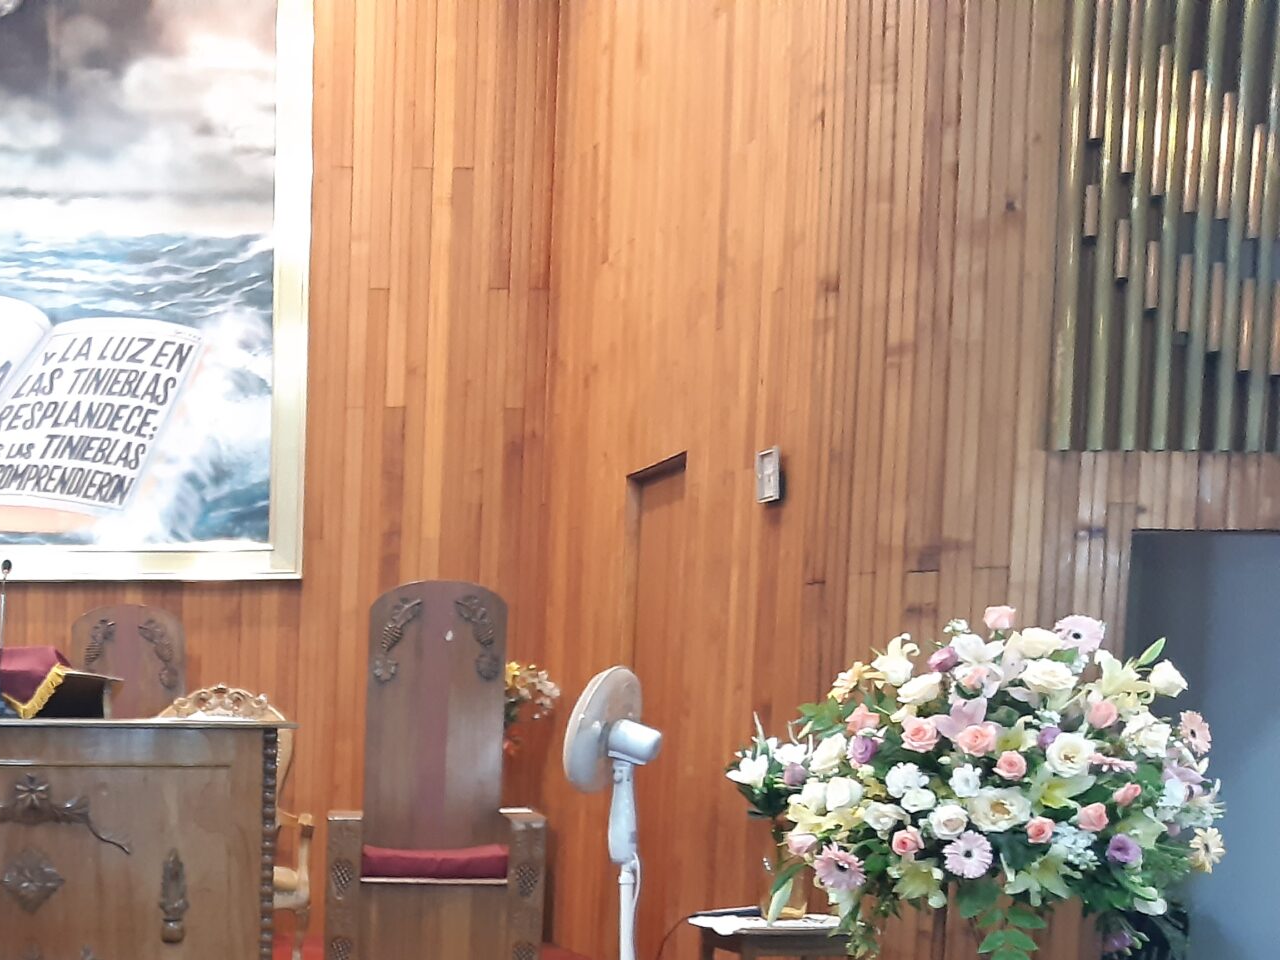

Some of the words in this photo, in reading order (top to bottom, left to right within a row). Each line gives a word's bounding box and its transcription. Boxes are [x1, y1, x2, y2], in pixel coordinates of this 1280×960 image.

[58, 337, 92, 363] LA
[98, 337, 156, 363] LUZ
[151, 341, 193, 372] EN
[12, 368, 63, 399] LAS
[68, 368, 176, 406] TINIEBLAS
[6, 443, 35, 459] LAS
[40, 434, 146, 470] TINIEBLAS
